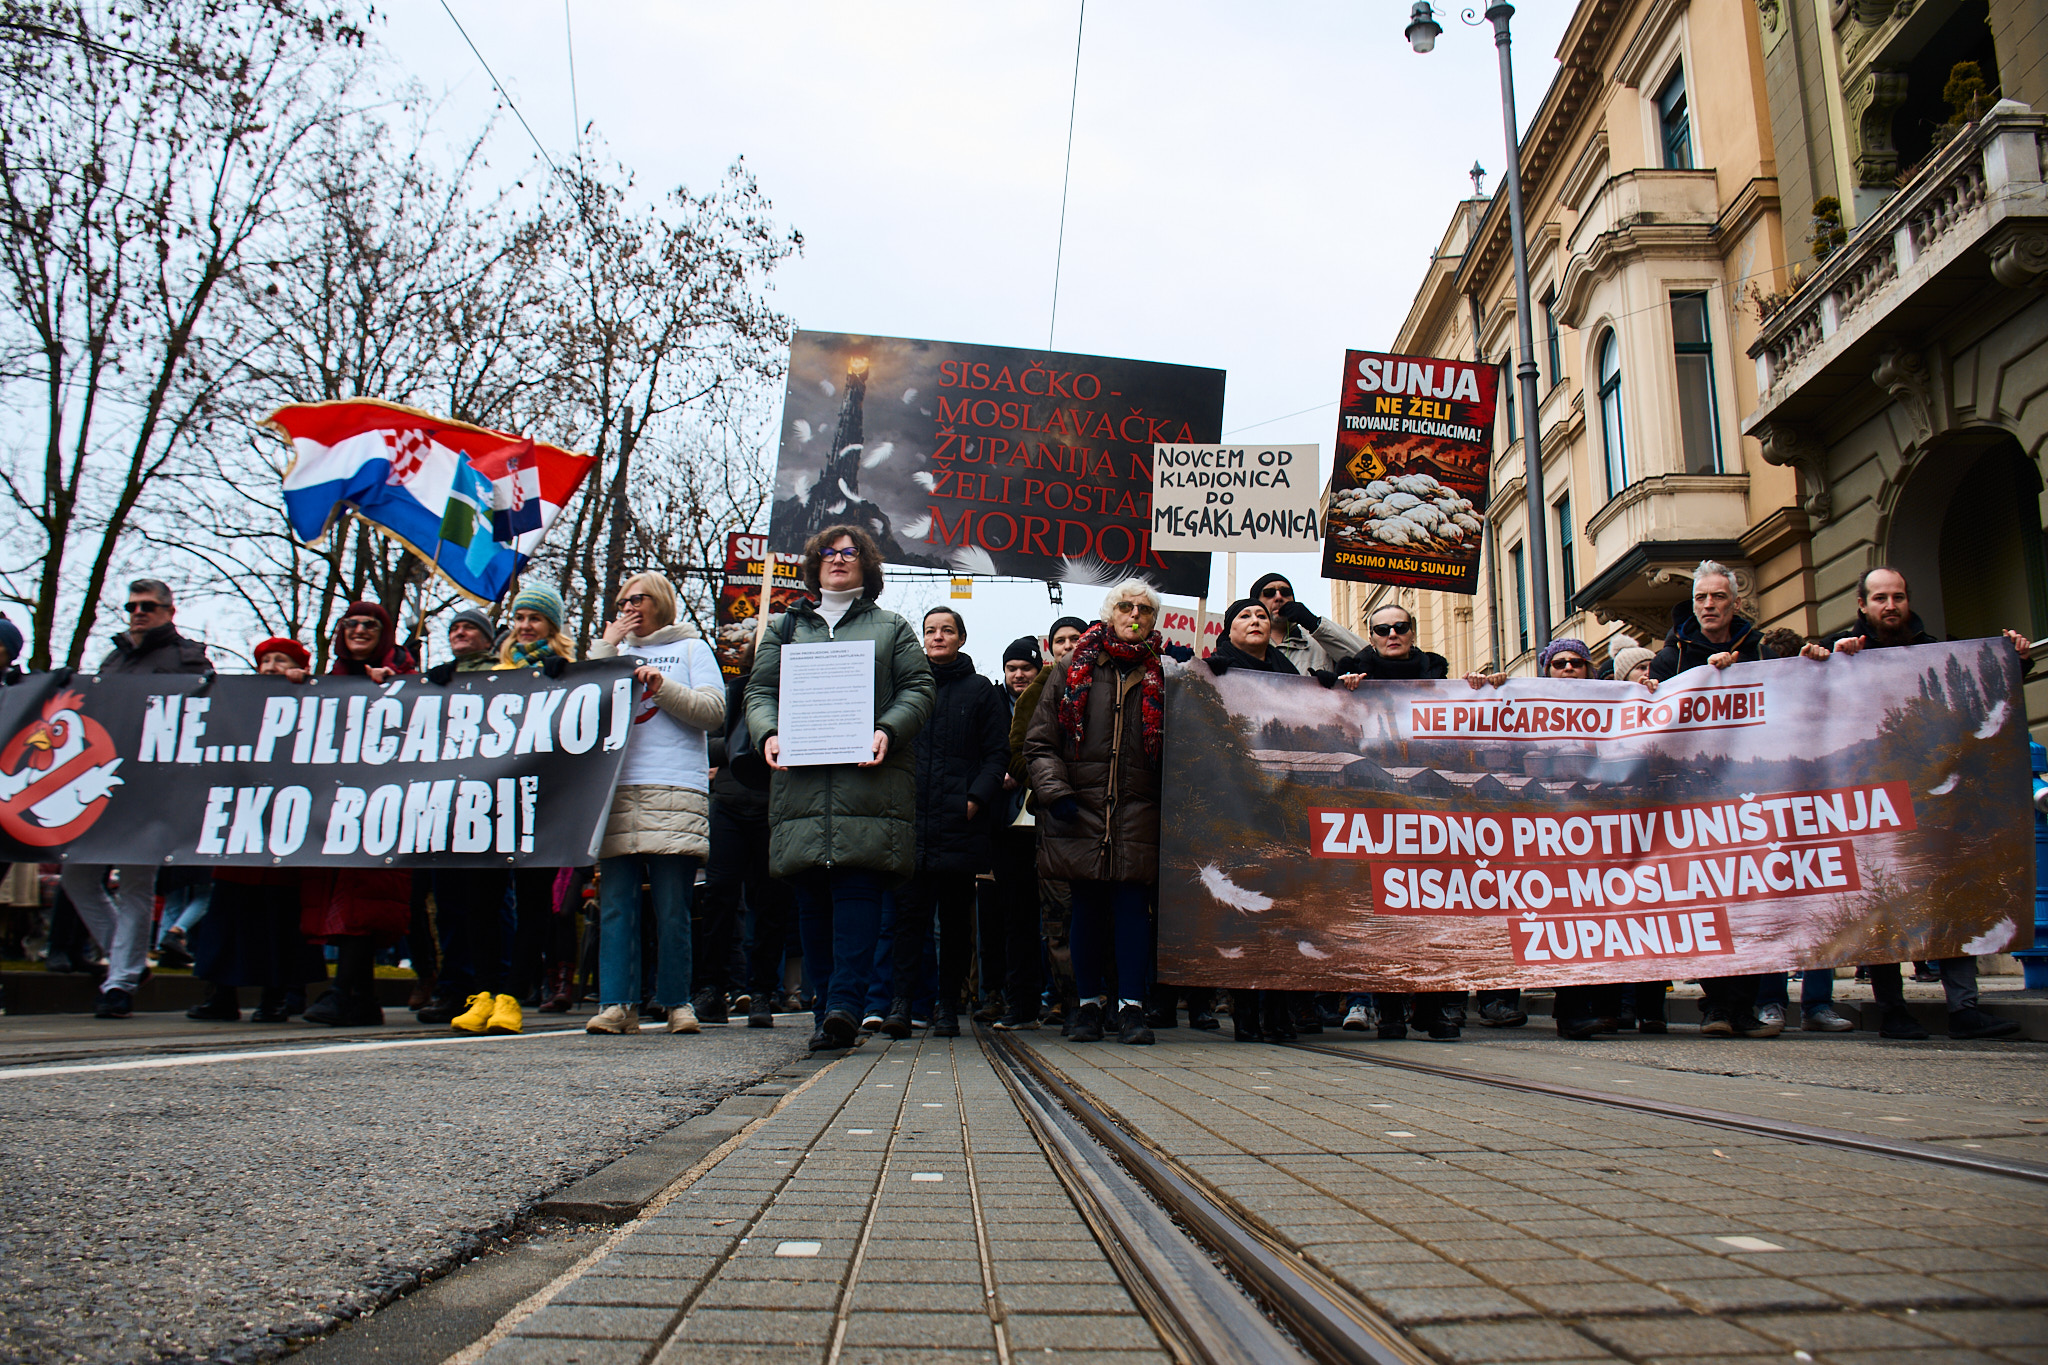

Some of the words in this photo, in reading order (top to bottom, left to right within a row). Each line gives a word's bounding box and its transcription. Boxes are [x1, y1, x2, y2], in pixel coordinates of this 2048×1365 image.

[938, 360, 1101, 401] SISAČKO
[1357, 358, 1480, 402] SUNJA
[934, 396, 1194, 445] MOSLAVAČKA
[1345, 416, 1399, 431] TROVANJE
[1402, 418, 1481, 442] PILIĆNJACIMA!
[1375, 396, 1402, 415] NE
[1408, 396, 1451, 420] ŽELI
[931, 425, 1118, 480] ŽUPANIJA
[1128, 453, 1154, 482] N
[1158, 447, 1244, 469] NOVCEM
[1258, 451, 1293, 466] OD
[928, 461, 1011, 504] ŽELI
[1021, 478, 1154, 520] POSTAT
[1160, 469, 1290, 488] KLADIONICA
[1206, 491, 1234, 505] DO
[924, 505, 1169, 570] MORDOR
[1154, 505, 1318, 541] MEGAKLAONICA
[747, 562, 765, 575] NE
[1335, 551, 1386, 569] SPASIMO
[1388, 557, 1418, 571] NAŠU
[1421, 562, 1466, 577] SUNJU!
[1412, 707, 1446, 731] NE
[1453, 700, 1613, 733] PILIĆARSKOJ
[1620, 705, 1672, 731] EKO
[1678, 691, 1765, 724] BOMBI!
[196, 785, 313, 856] EKO
[321, 775, 539, 855] BOMBI!
[1321, 812, 1504, 855] ZAJEDNO
[1512, 812, 1656, 857] PROTIV
[1663, 788, 1901, 850] UNIŠTENJA
[1384, 841, 1847, 909] SISAČKO-MOSLAVAČKE
[1523, 911, 1721, 963] ŽUPANIJE
